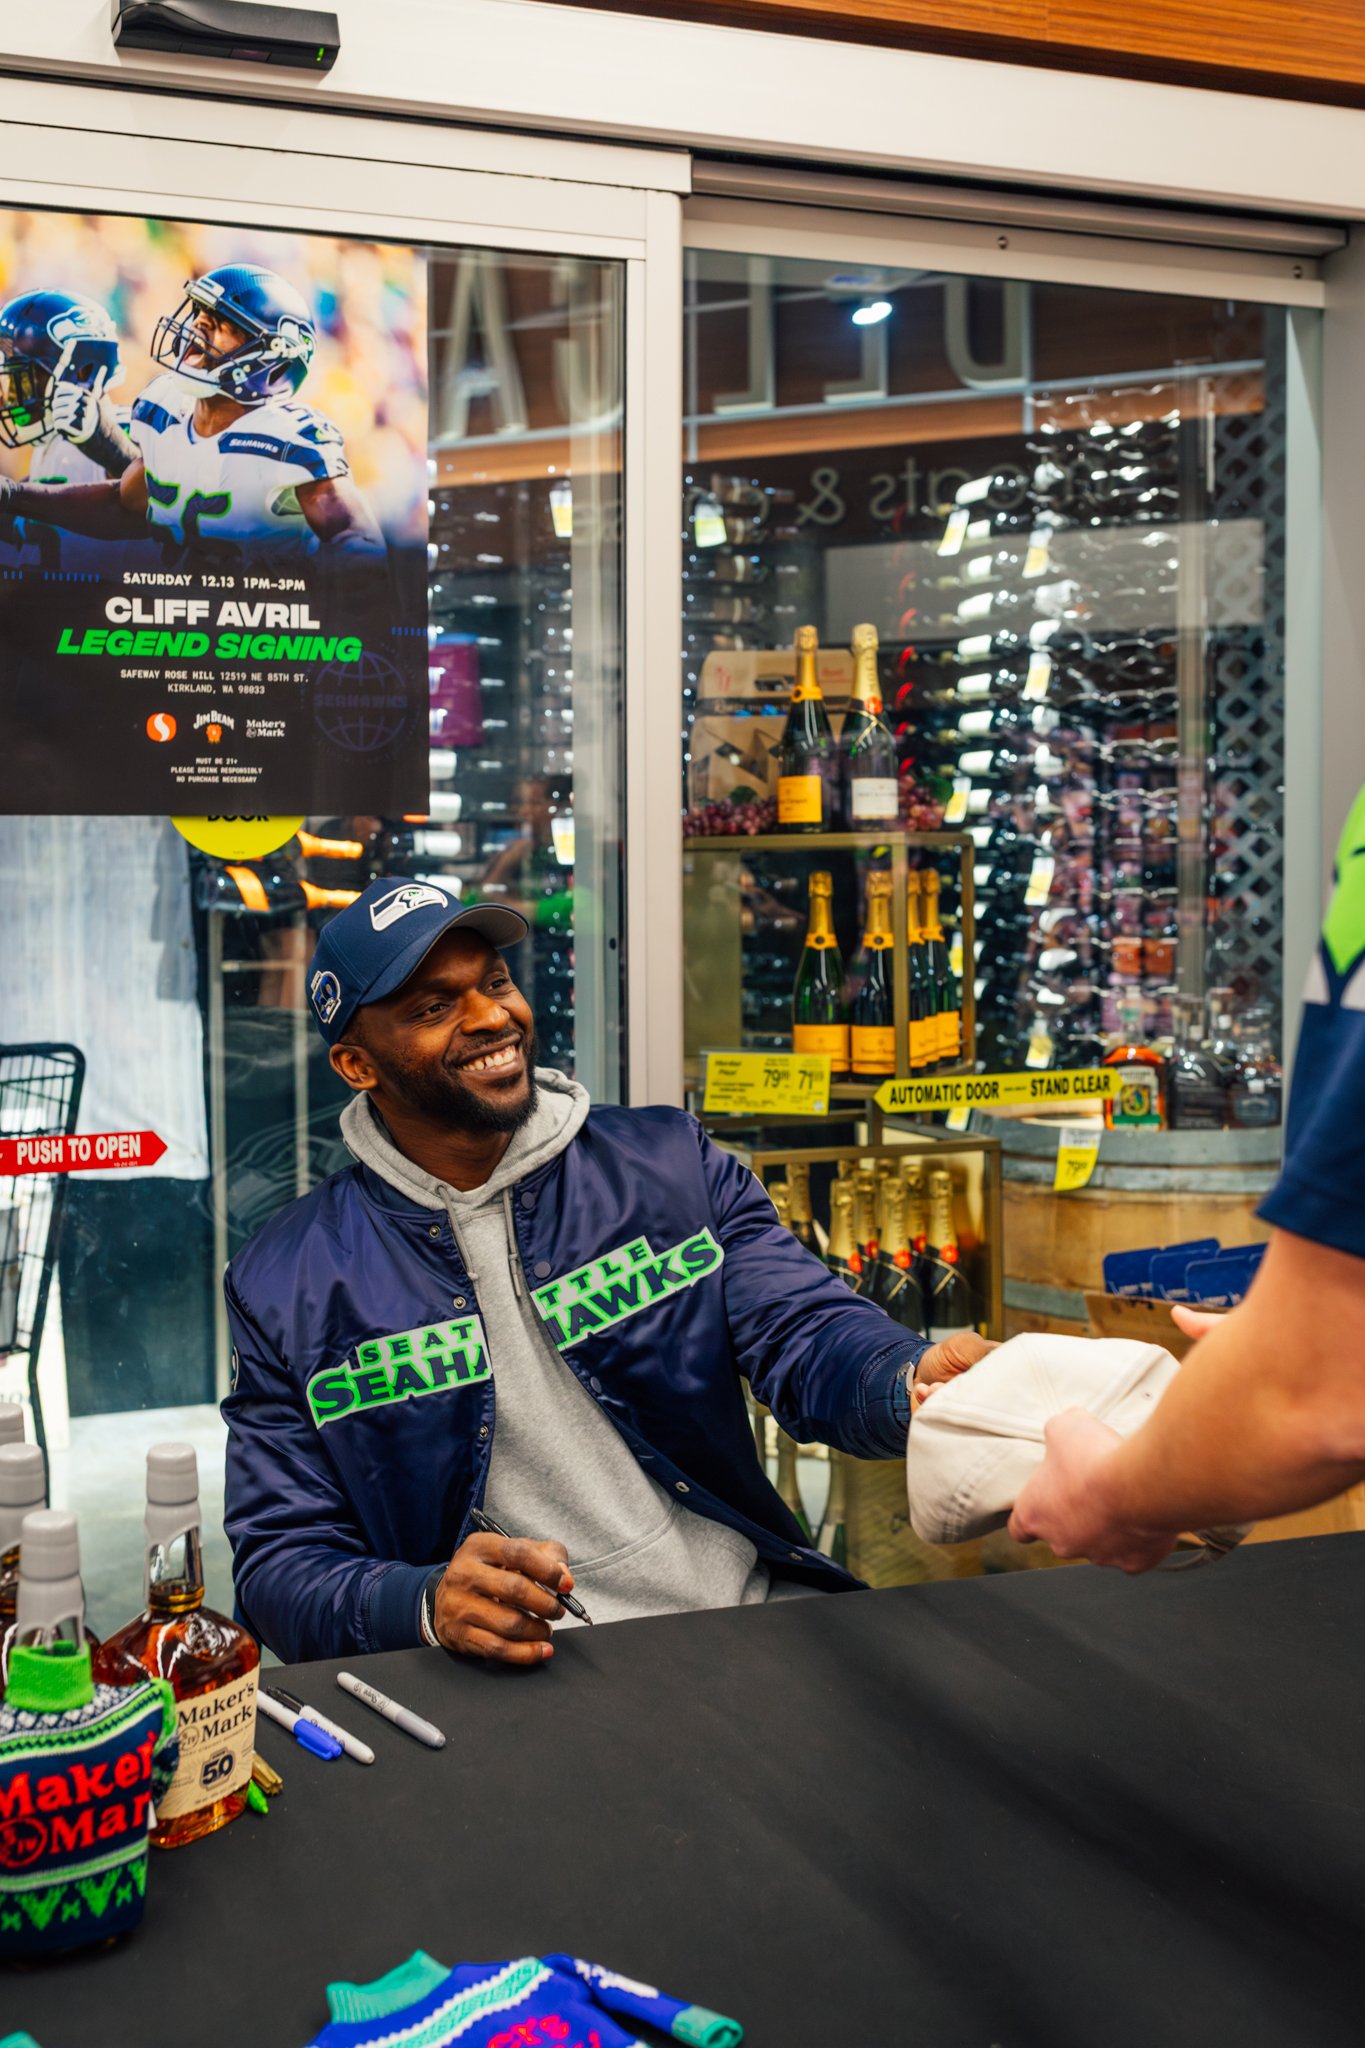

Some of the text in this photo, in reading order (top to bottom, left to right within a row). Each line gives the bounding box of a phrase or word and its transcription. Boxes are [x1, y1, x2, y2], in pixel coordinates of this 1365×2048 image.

[123, 572, 192, 586] SATURDAY
[201, 574, 235, 588] 12.13
[104, 597, 321, 629] CLIFF AVRIL
[56, 628, 363, 663] LEGEND SIGNING
[120, 669, 309, 683] SAFEWAY ROSE HILL 12519 NE 85TH ST.
[167, 684, 266, 694] KIRKLAND, WA 98033
[246, 719, 286, 729] Maker's
[256, 728, 285, 737] Mark
[889, 1075, 1111, 1105] AUTOMATIC DOOR STAND CLEAR
[17, 1134, 141, 1165] PUSH TO OPEN
[361, 1321, 474, 1364] SEAT
[178, 1682, 254, 1727] Maker's
[202, 1704, 253, 1743] Mark
[203, 1754, 233, 1784] 50
